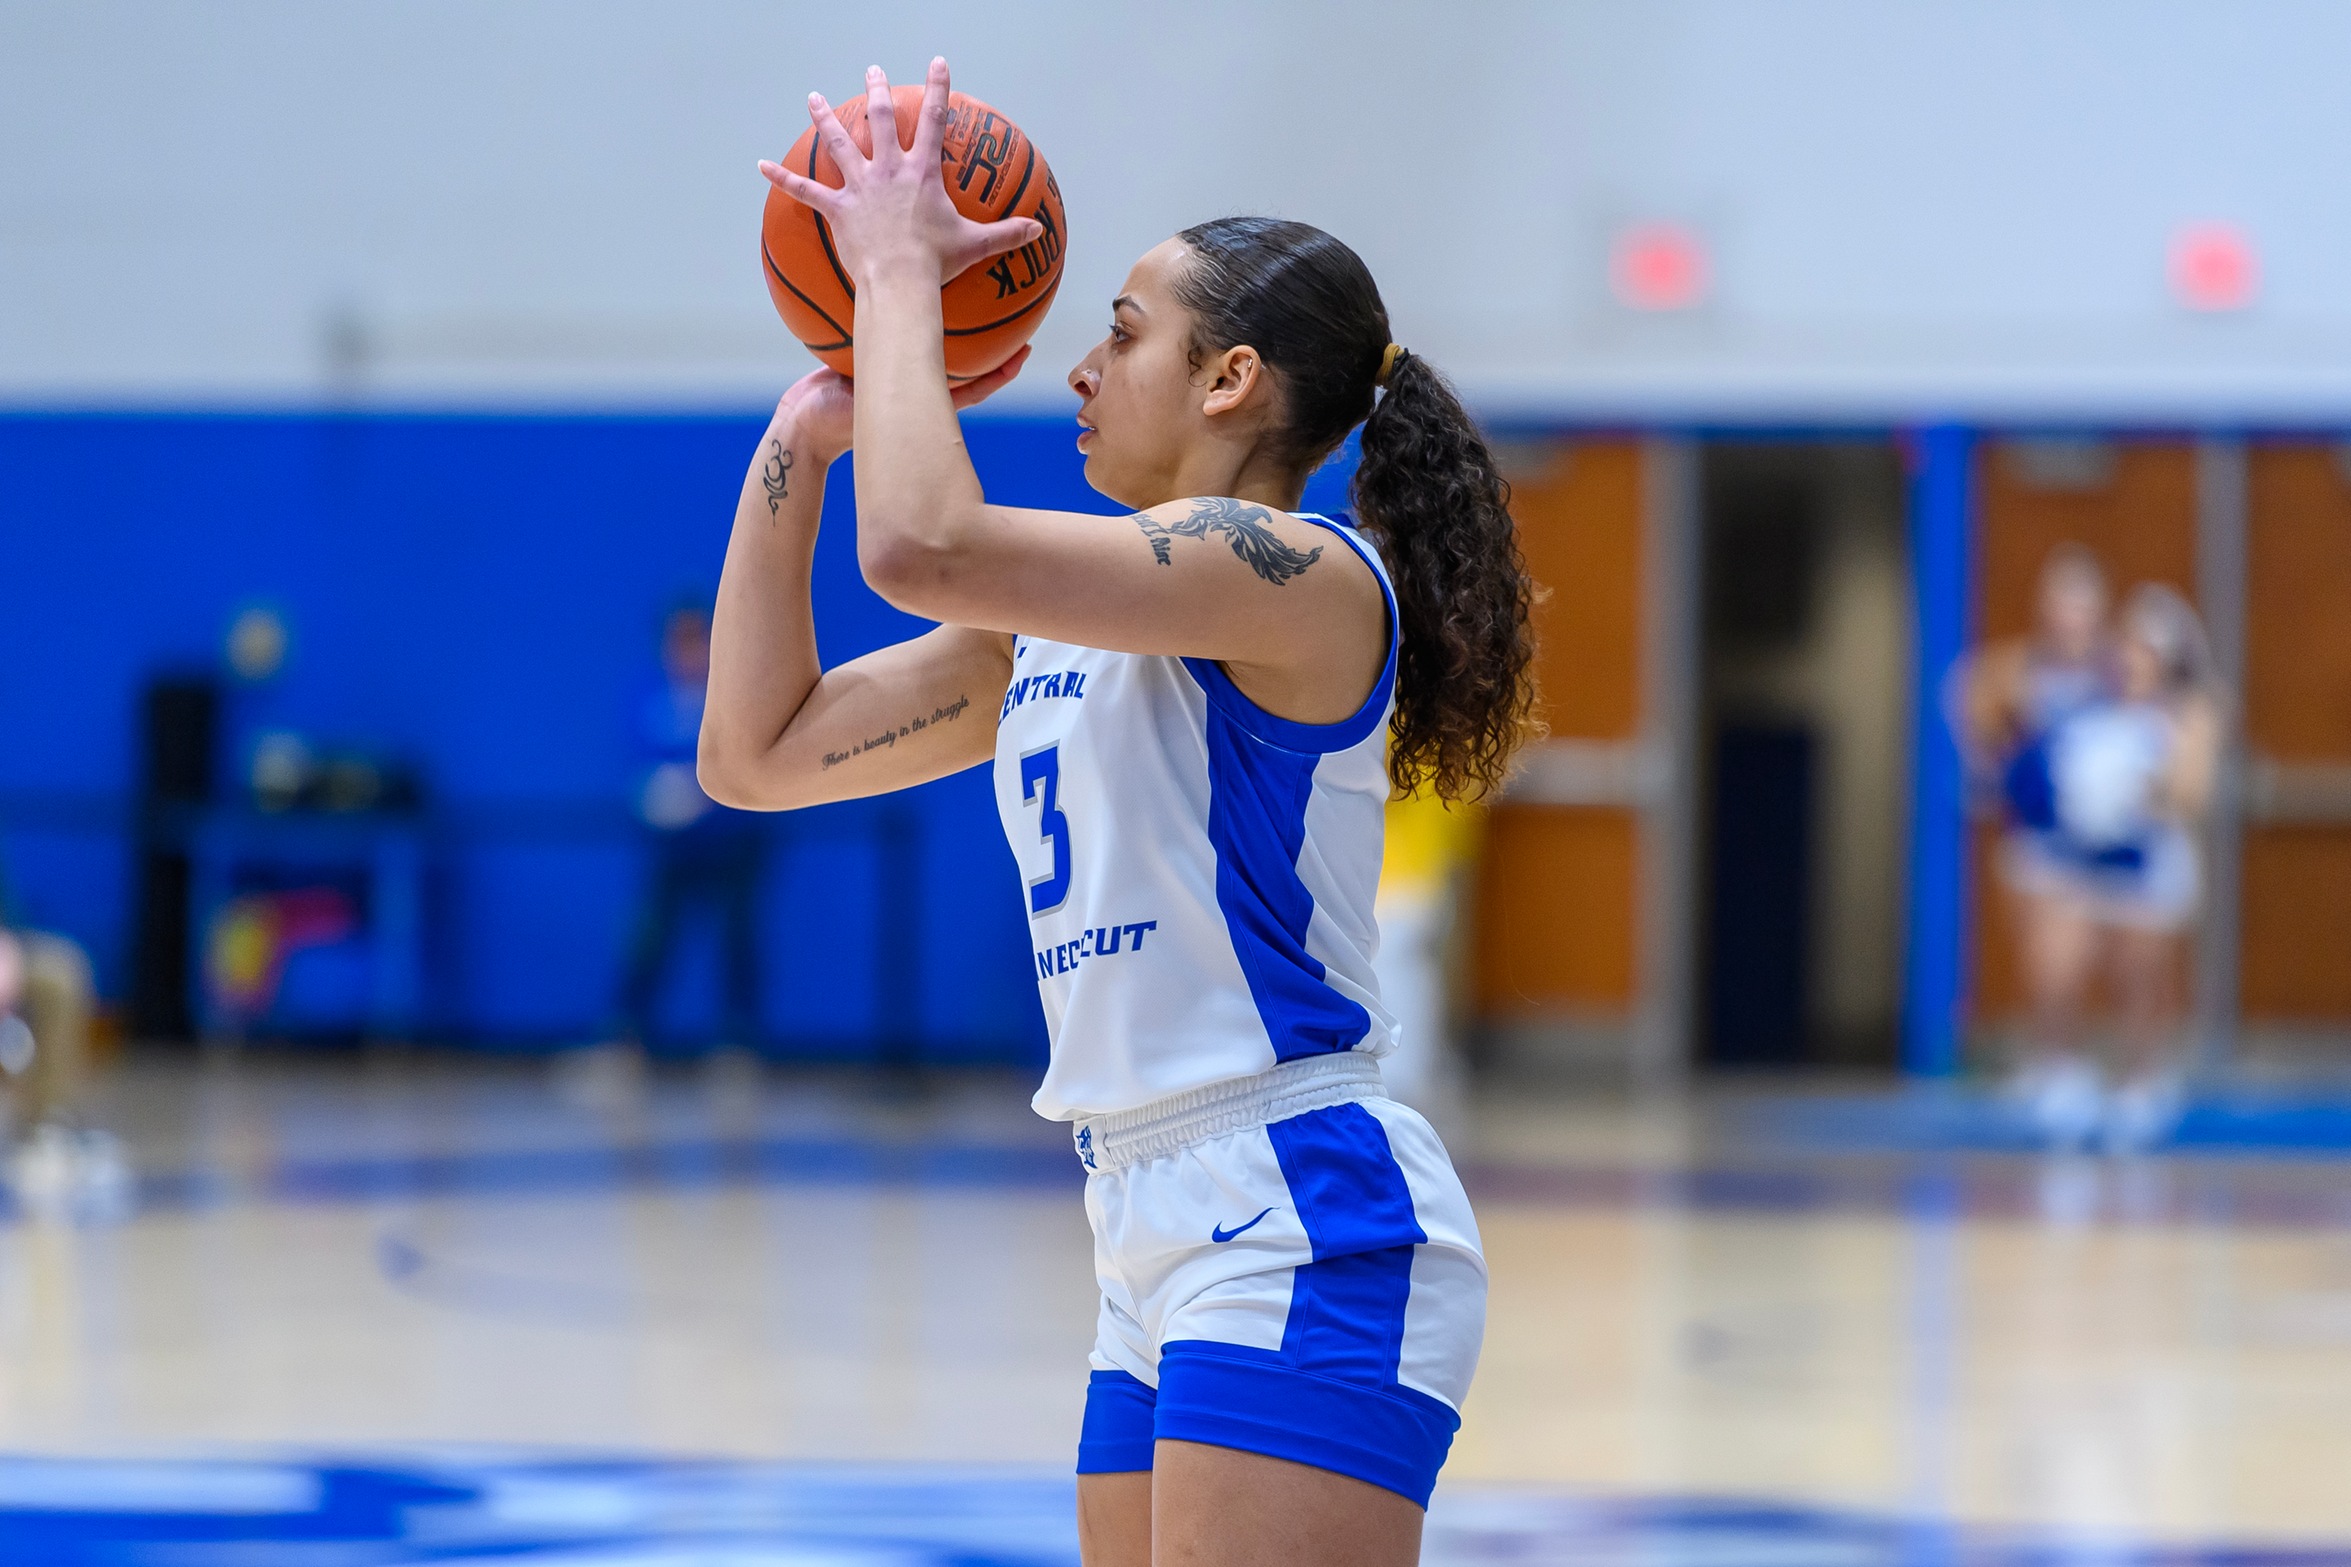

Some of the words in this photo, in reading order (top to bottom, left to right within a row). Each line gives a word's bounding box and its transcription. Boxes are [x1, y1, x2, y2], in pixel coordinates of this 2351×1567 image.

[822, 752, 850, 771] There
[853, 745, 861, 756] is
[864, 730, 897, 748] beauty
[900, 726, 910, 737] in
[912, 716, 928, 732] the
[930, 694, 969, 725] struggle
[1000, 670, 1087, 724] ENTRAL
[1019, 738, 1074, 921] 3
